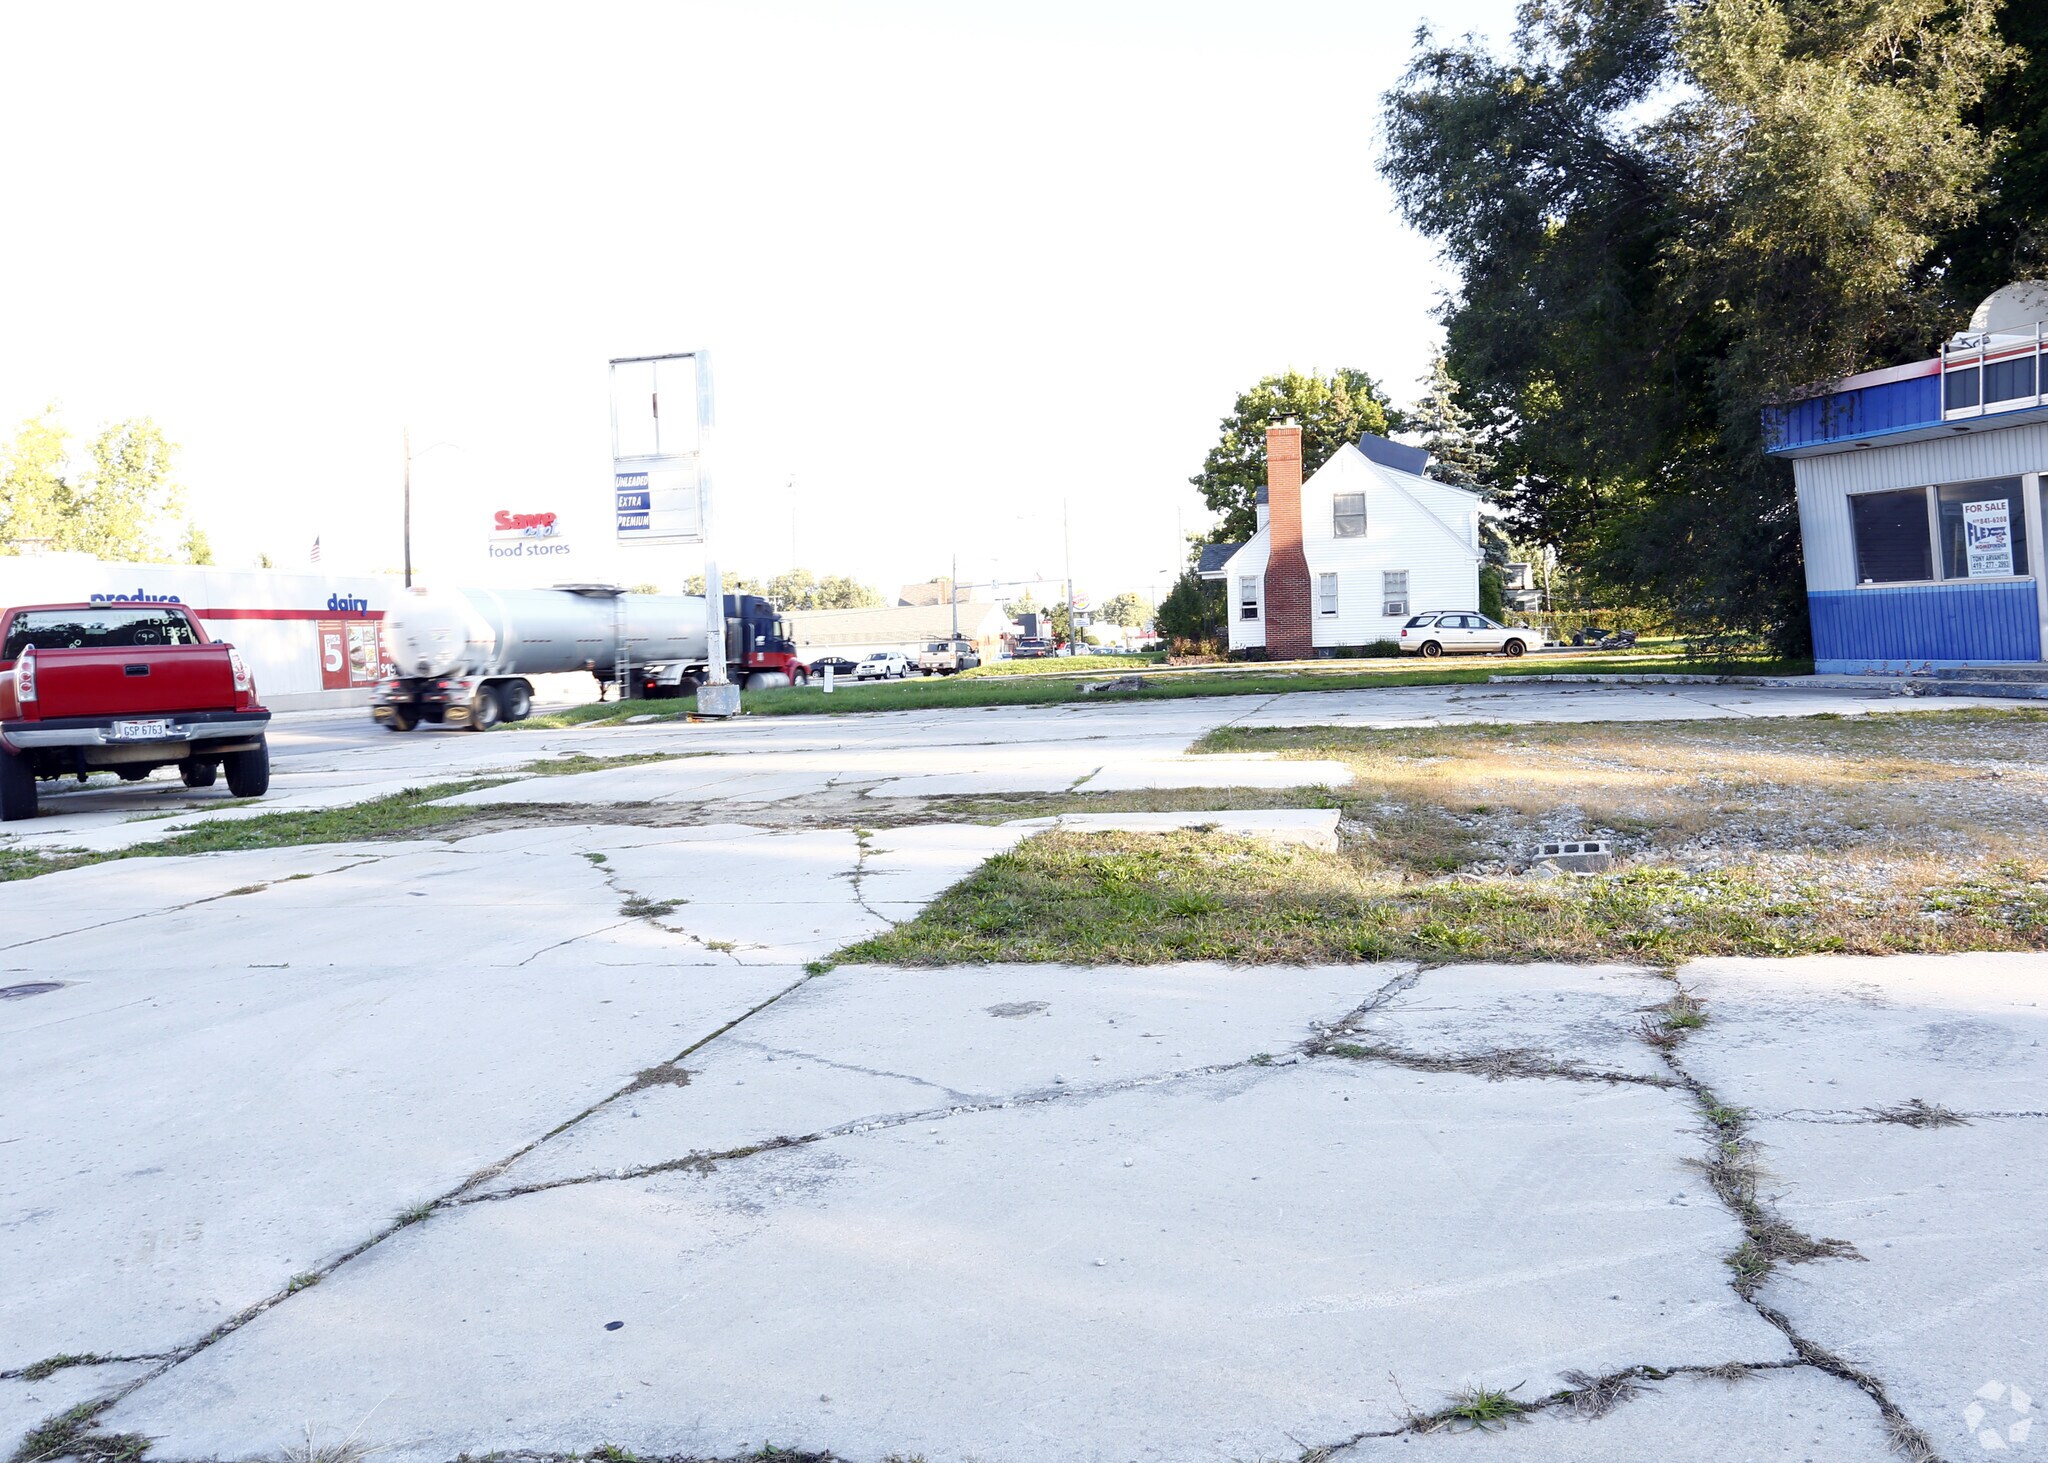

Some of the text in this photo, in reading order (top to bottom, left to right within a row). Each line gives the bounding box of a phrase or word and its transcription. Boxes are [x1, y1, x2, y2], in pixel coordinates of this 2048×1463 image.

[616, 475, 648, 488] UNLEADED
[618, 495, 642, 508] EXTRA
[1965, 502, 2006, 513] FOR SALE
[618, 515, 649, 527] PREMIUM
[489, 542, 570, 558] food stores
[327, 593, 367, 617] dairy
[324, 634, 343, 672] 5
[124, 725, 162, 736] GSP 6763
